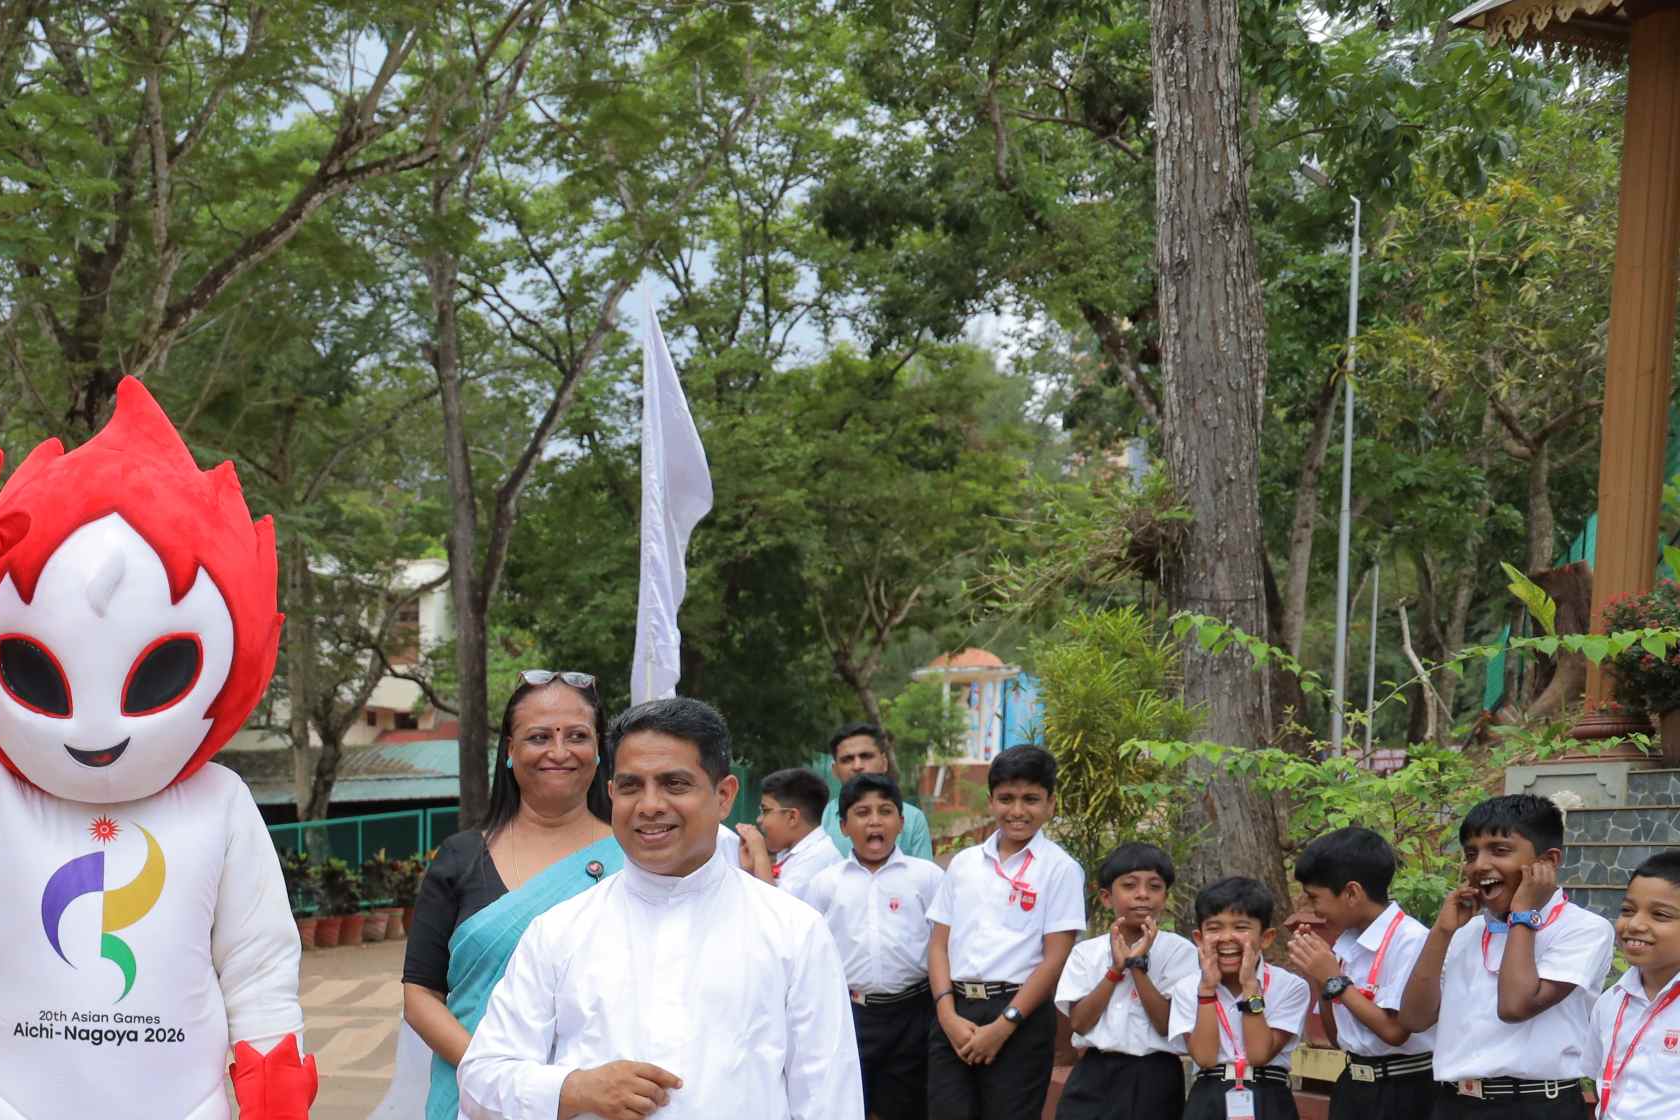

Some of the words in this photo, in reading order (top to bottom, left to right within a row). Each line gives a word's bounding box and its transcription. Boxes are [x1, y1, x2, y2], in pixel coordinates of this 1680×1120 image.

[39, 1010, 67, 1022] 20th
[71, 1011, 109, 1023] Asian
[113, 1012, 161, 1025] Games
[13, 1022, 139, 1047] Aichi-Nagoya
[143, 1027, 186, 1043] 2026
